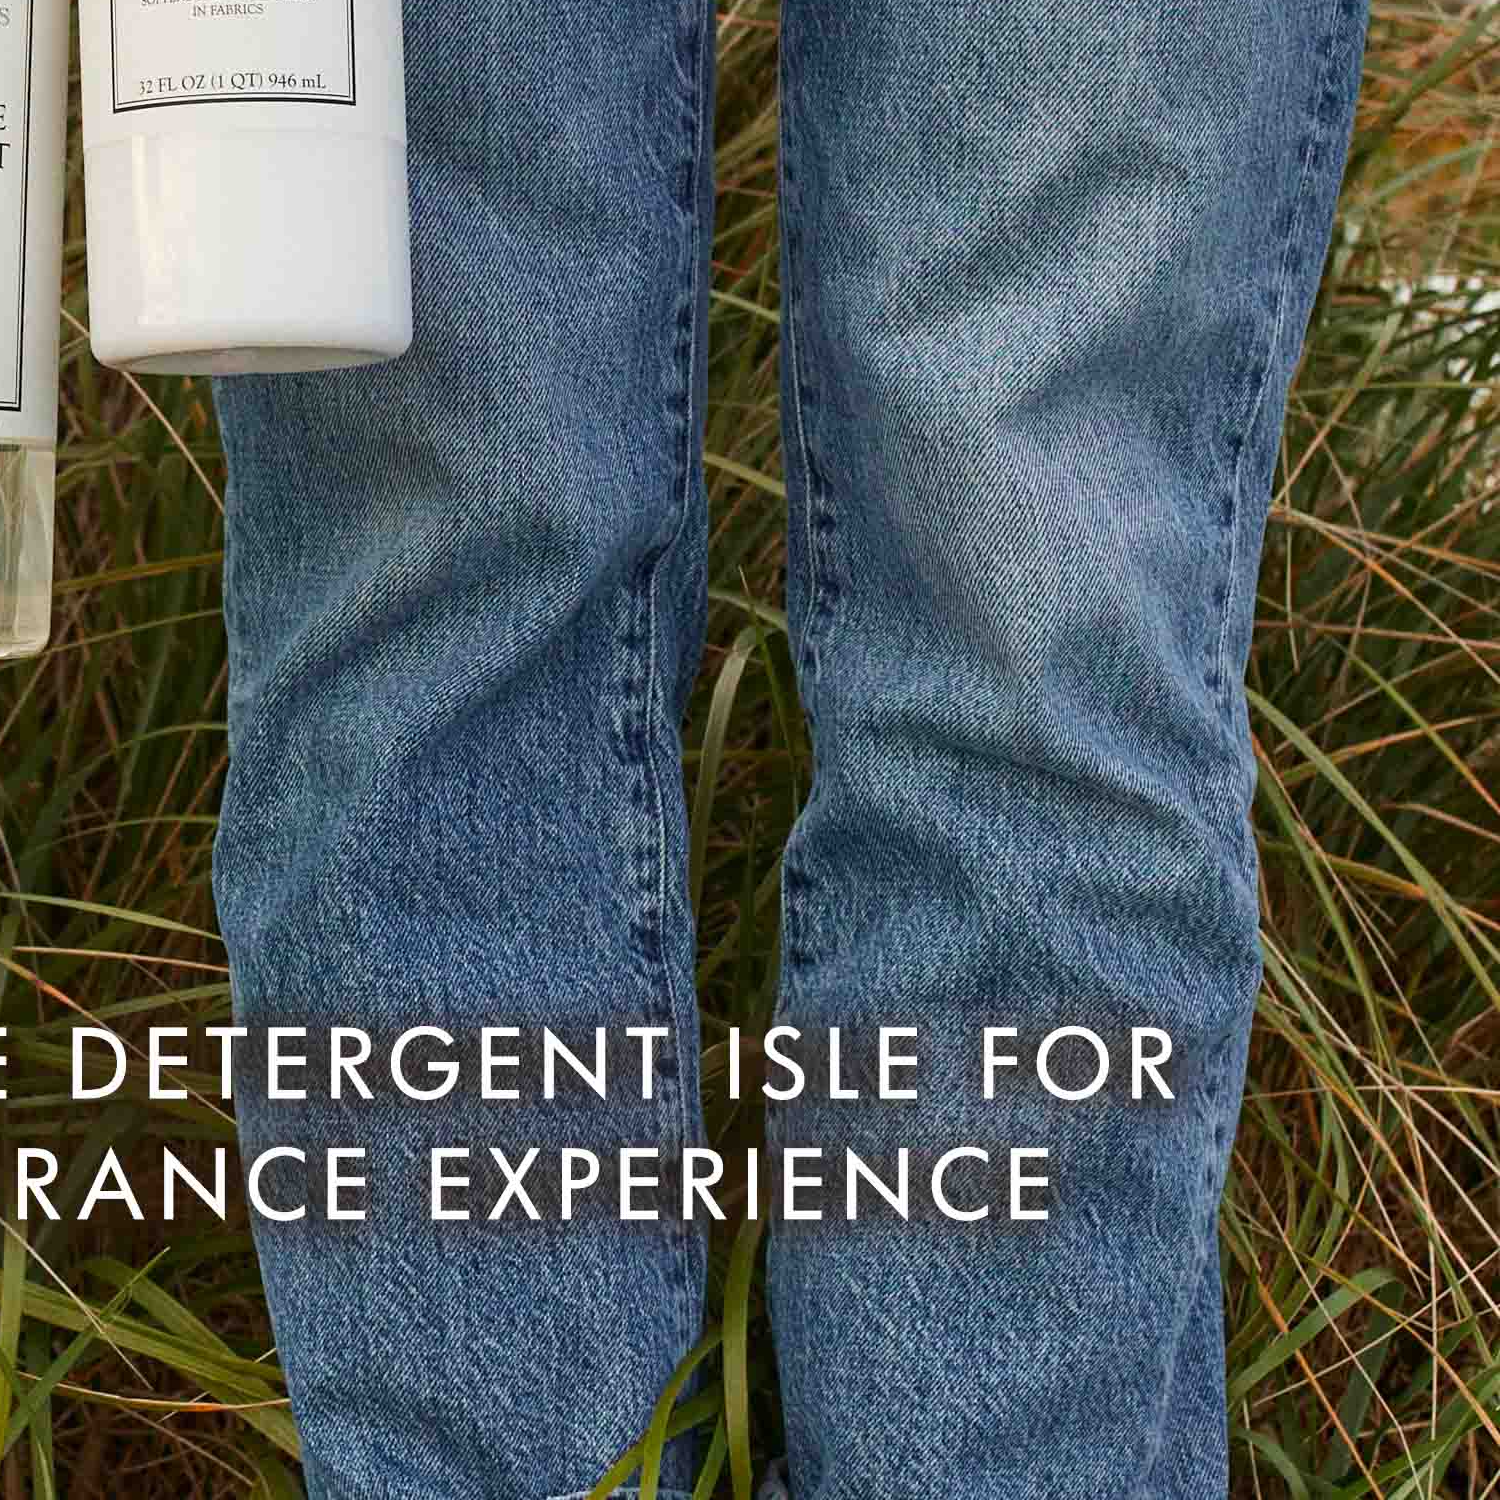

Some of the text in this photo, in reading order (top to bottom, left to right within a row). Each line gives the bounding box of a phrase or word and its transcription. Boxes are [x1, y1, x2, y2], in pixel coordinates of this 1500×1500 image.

[192, 4, 264, 17] IN FABRICS
[140, 81, 153, 95] 32
[158, 78, 177, 93] FL
[181, 75, 205, 90] OZ
[211, 74, 224, 90] (1
[230, 72, 263, 90] QT)
[268, 73, 297, 88] 946
